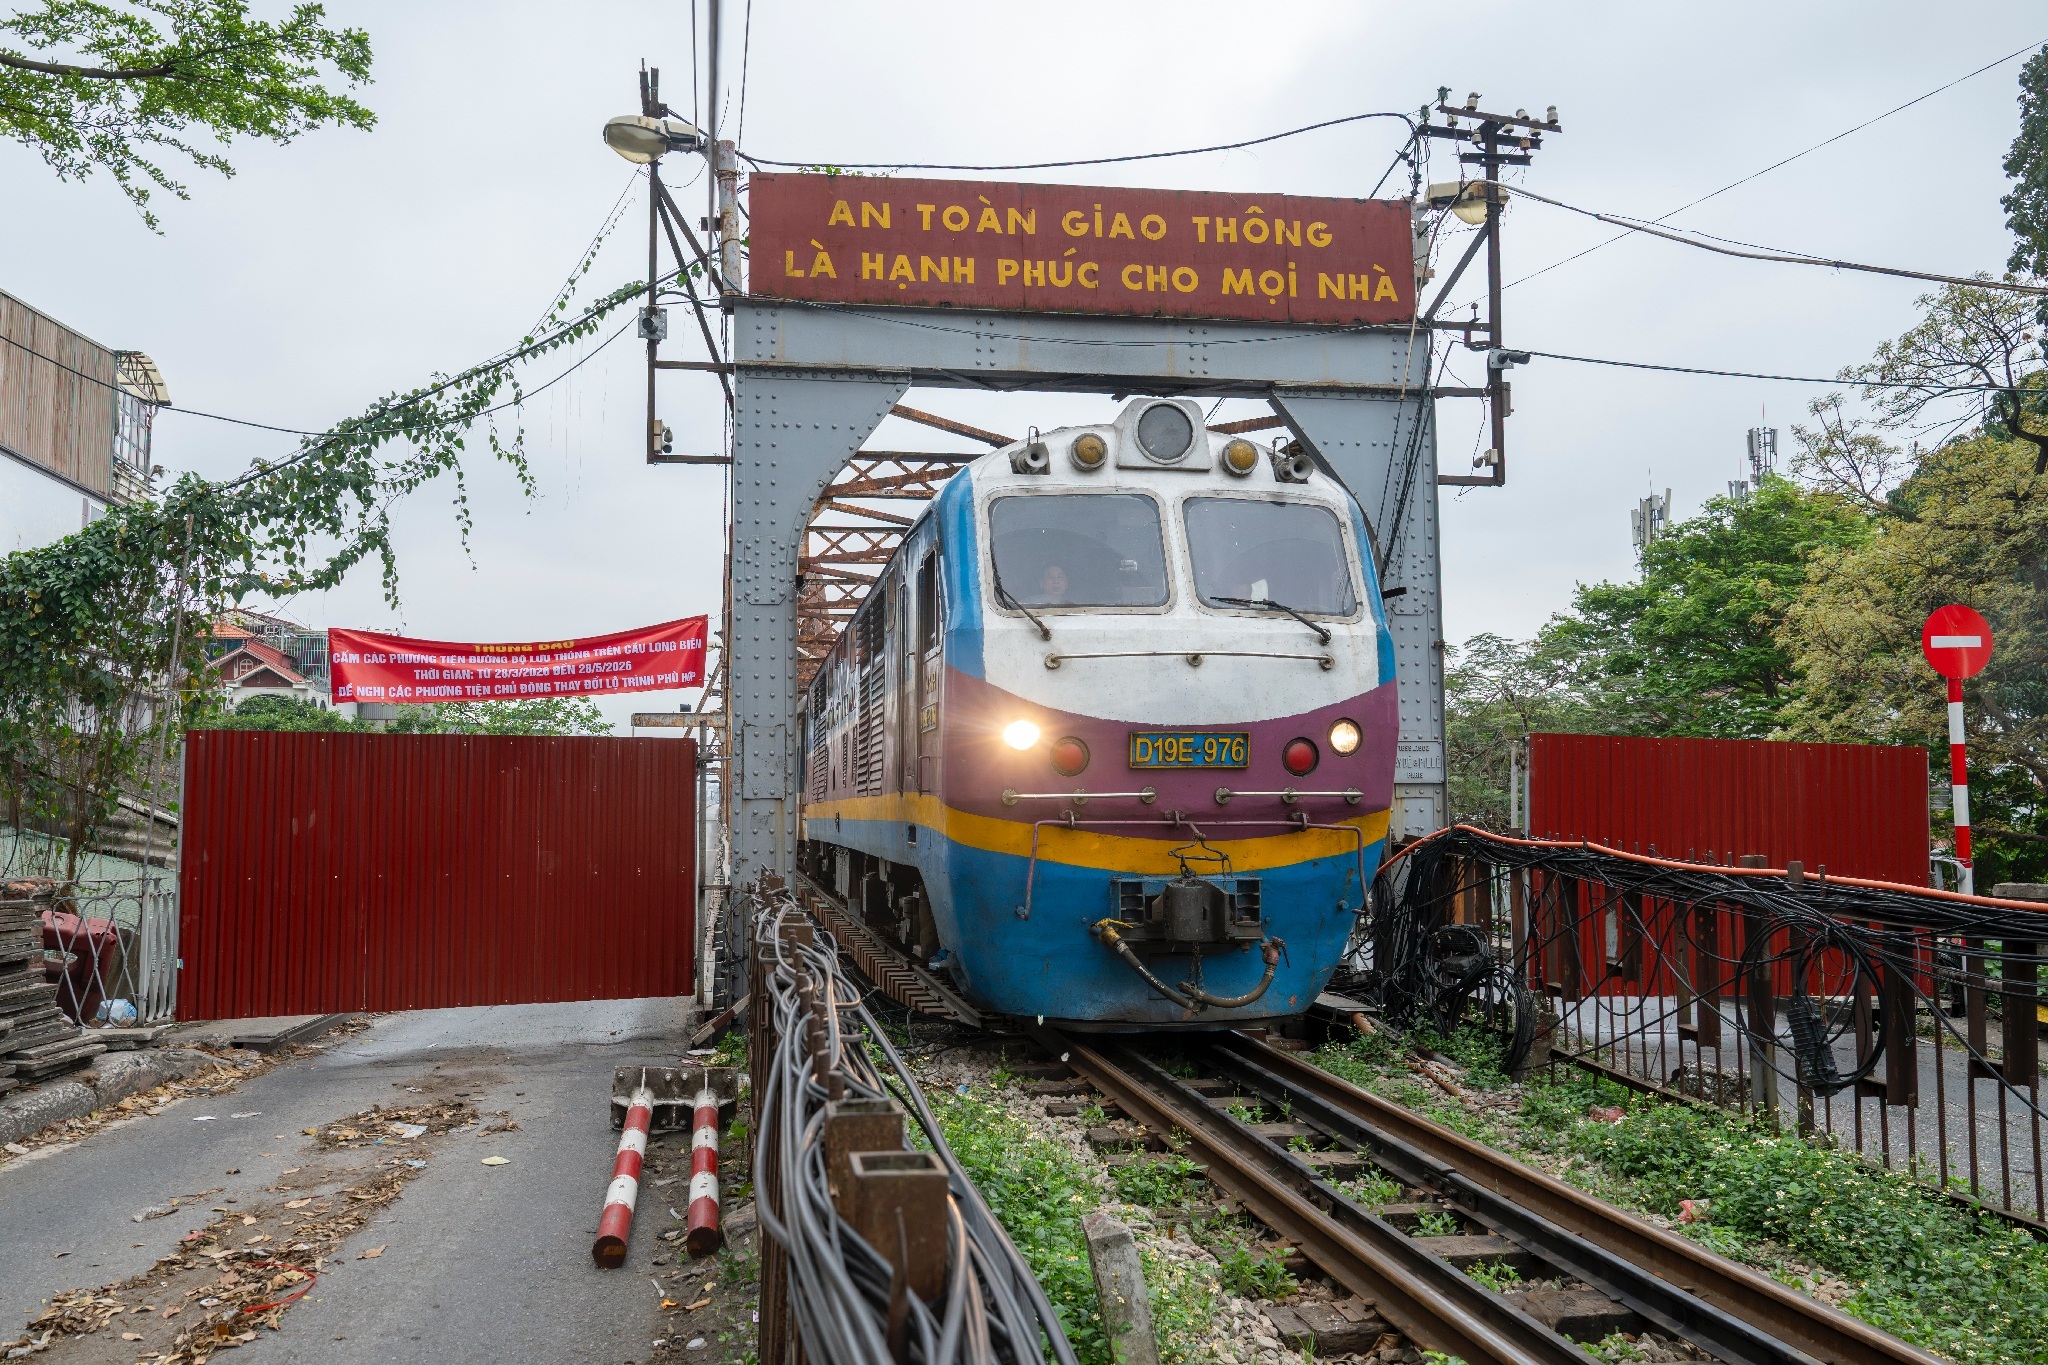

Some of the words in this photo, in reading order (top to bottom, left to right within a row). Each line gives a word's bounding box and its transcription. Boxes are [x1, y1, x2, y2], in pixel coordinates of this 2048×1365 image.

[828, 201, 891, 229] AN
[916, 195, 1036, 235] TOÀN
[1192, 205, 1332, 248] THÔNG
[785, 239, 836, 278] LÀ
[861, 252, 975, 290] HẠNH
[997, 247, 1099, 289] PHÚC
[1121, 264, 1199, 293] CHO
[1318, 264, 1398, 302] NHÀ
[332, 650, 360, 664] CẤM
[363, 651, 387, 664] CÁC
[439, 654, 466, 666] TIỆN
[593, 645, 622, 657] TRÊN
[648, 640, 677, 653] LONG
[442, 669, 474, 680] GIAN:
[578, 661, 632, 674] 28/5/2026
[356, 686, 385, 699] NGHỊ
[388, 684, 412, 698] CÁC
[415, 685, 463, 698] PHƯƠNG
[464, 683, 491, 698] TIỆN
[494, 680, 517, 695] CHỦ
[520, 681, 551, 695] ĐỘNG
[553, 680, 581, 692] THAY
[622, 674, 655, 688] TRÌNH
[657, 670, 679, 684] PHÙ
[1135, 737, 1244, 763] D19E-976
